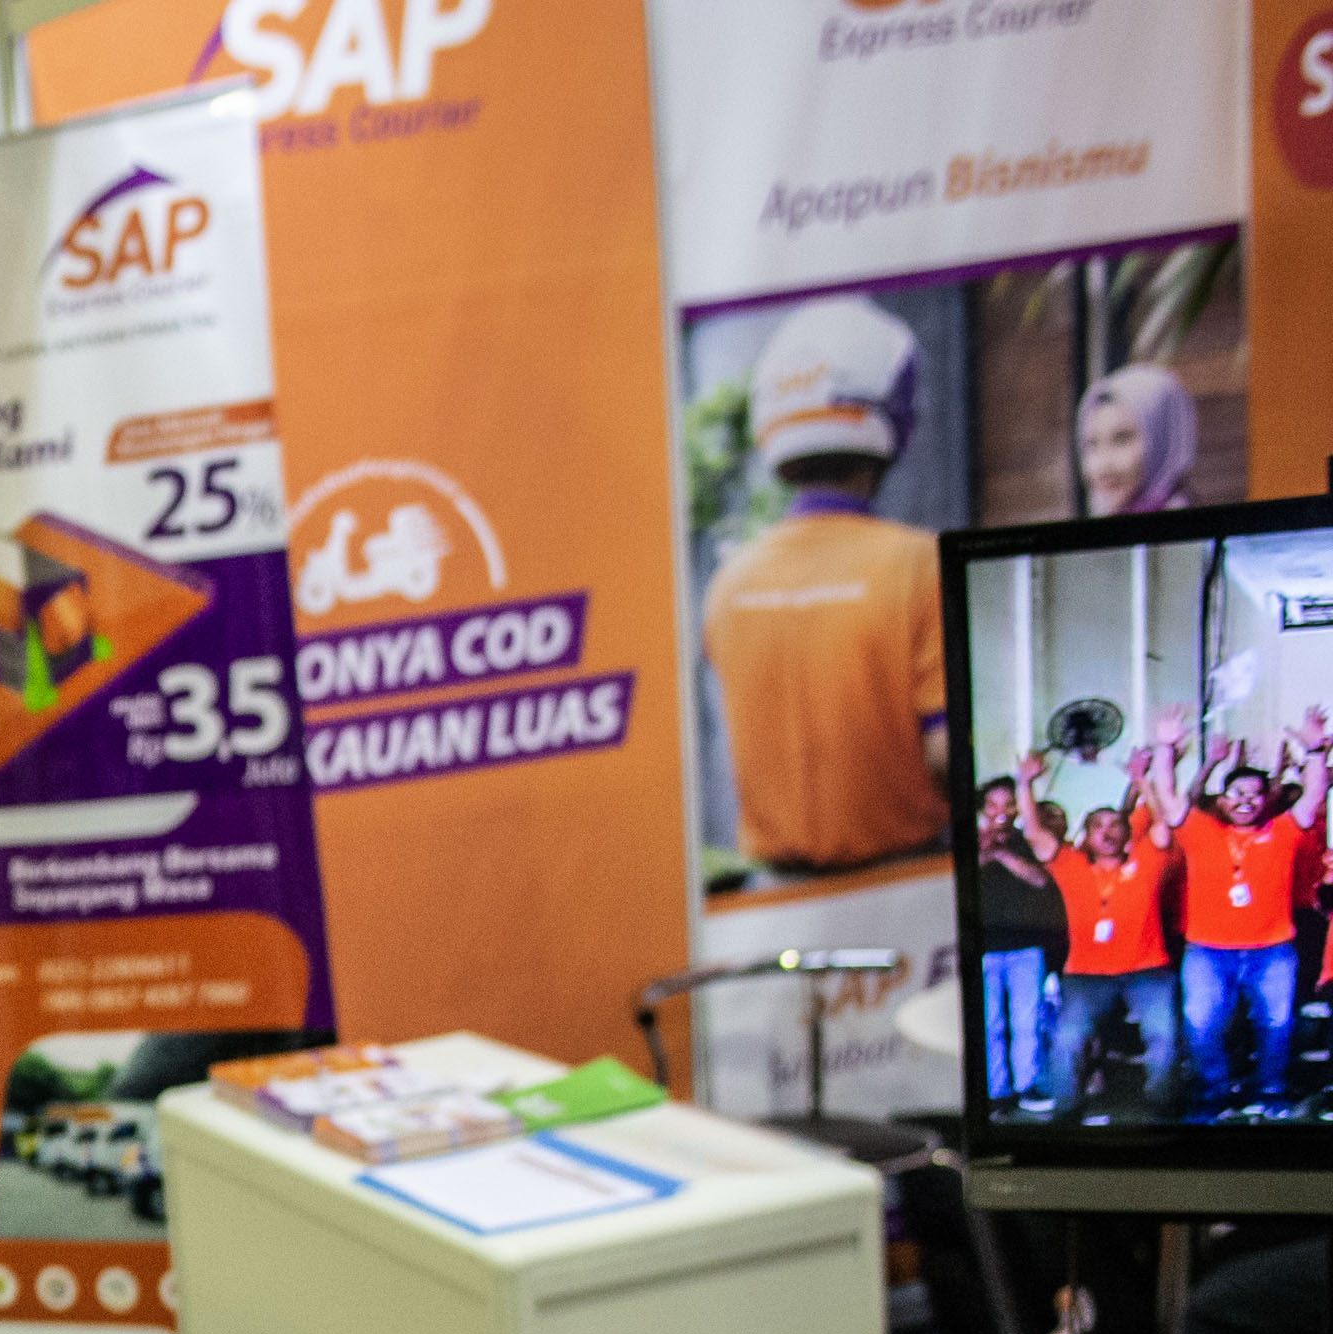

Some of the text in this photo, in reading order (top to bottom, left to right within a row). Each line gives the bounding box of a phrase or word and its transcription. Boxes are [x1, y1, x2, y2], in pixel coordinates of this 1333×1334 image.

[221, 0, 496, 117] SAP
[818, 14, 957, 63] Express
[259, 118, 339, 154] ress
[758, 138, 1152, 232] Apapun Bisnismu
[60, 196, 210, 292] SAP
[450, 604, 573, 678] COD
[485, 681, 624, 758] LUAS
